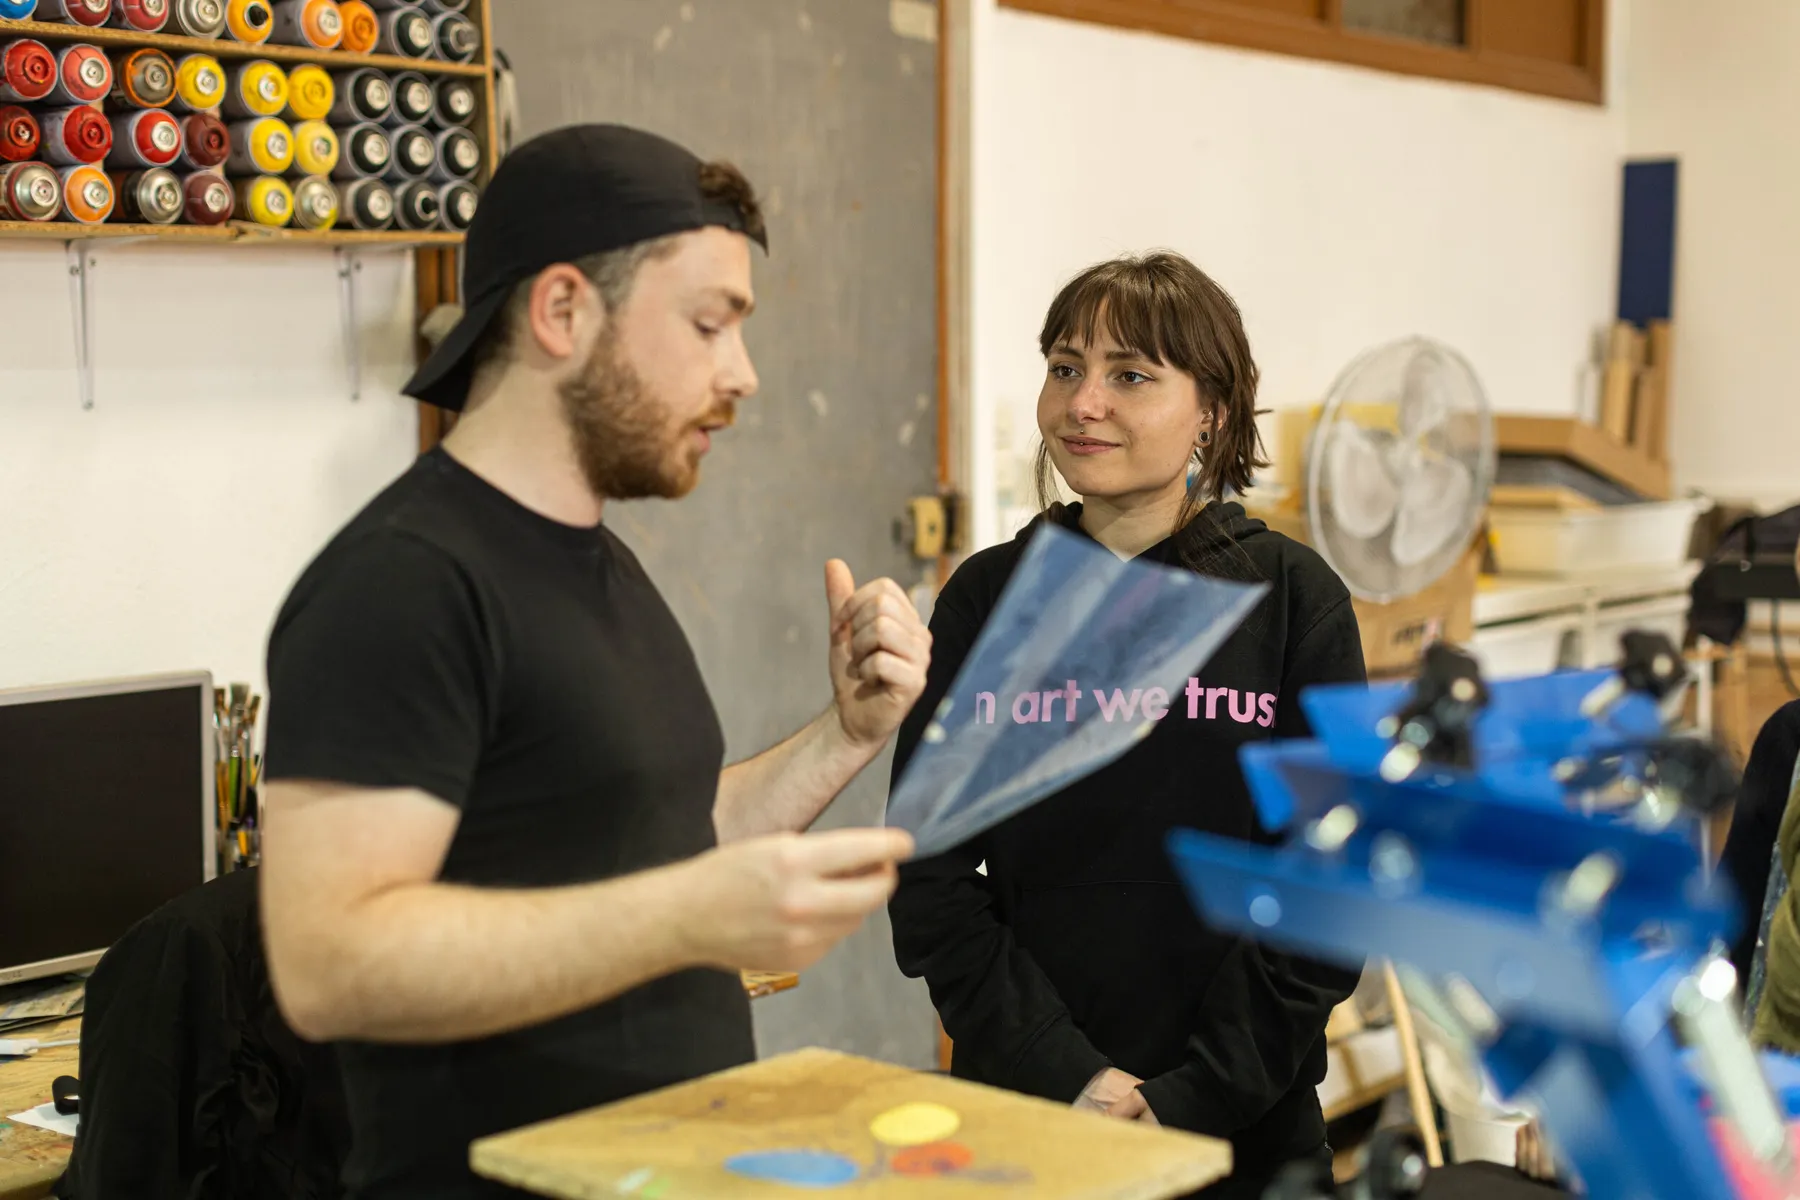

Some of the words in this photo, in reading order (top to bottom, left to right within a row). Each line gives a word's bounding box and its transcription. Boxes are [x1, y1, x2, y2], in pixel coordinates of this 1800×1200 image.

[975, 691, 996, 724] n
[1012, 680, 1082, 724] art
[1093, 687, 1169, 722] we
[1185, 677, 1277, 728] trus
